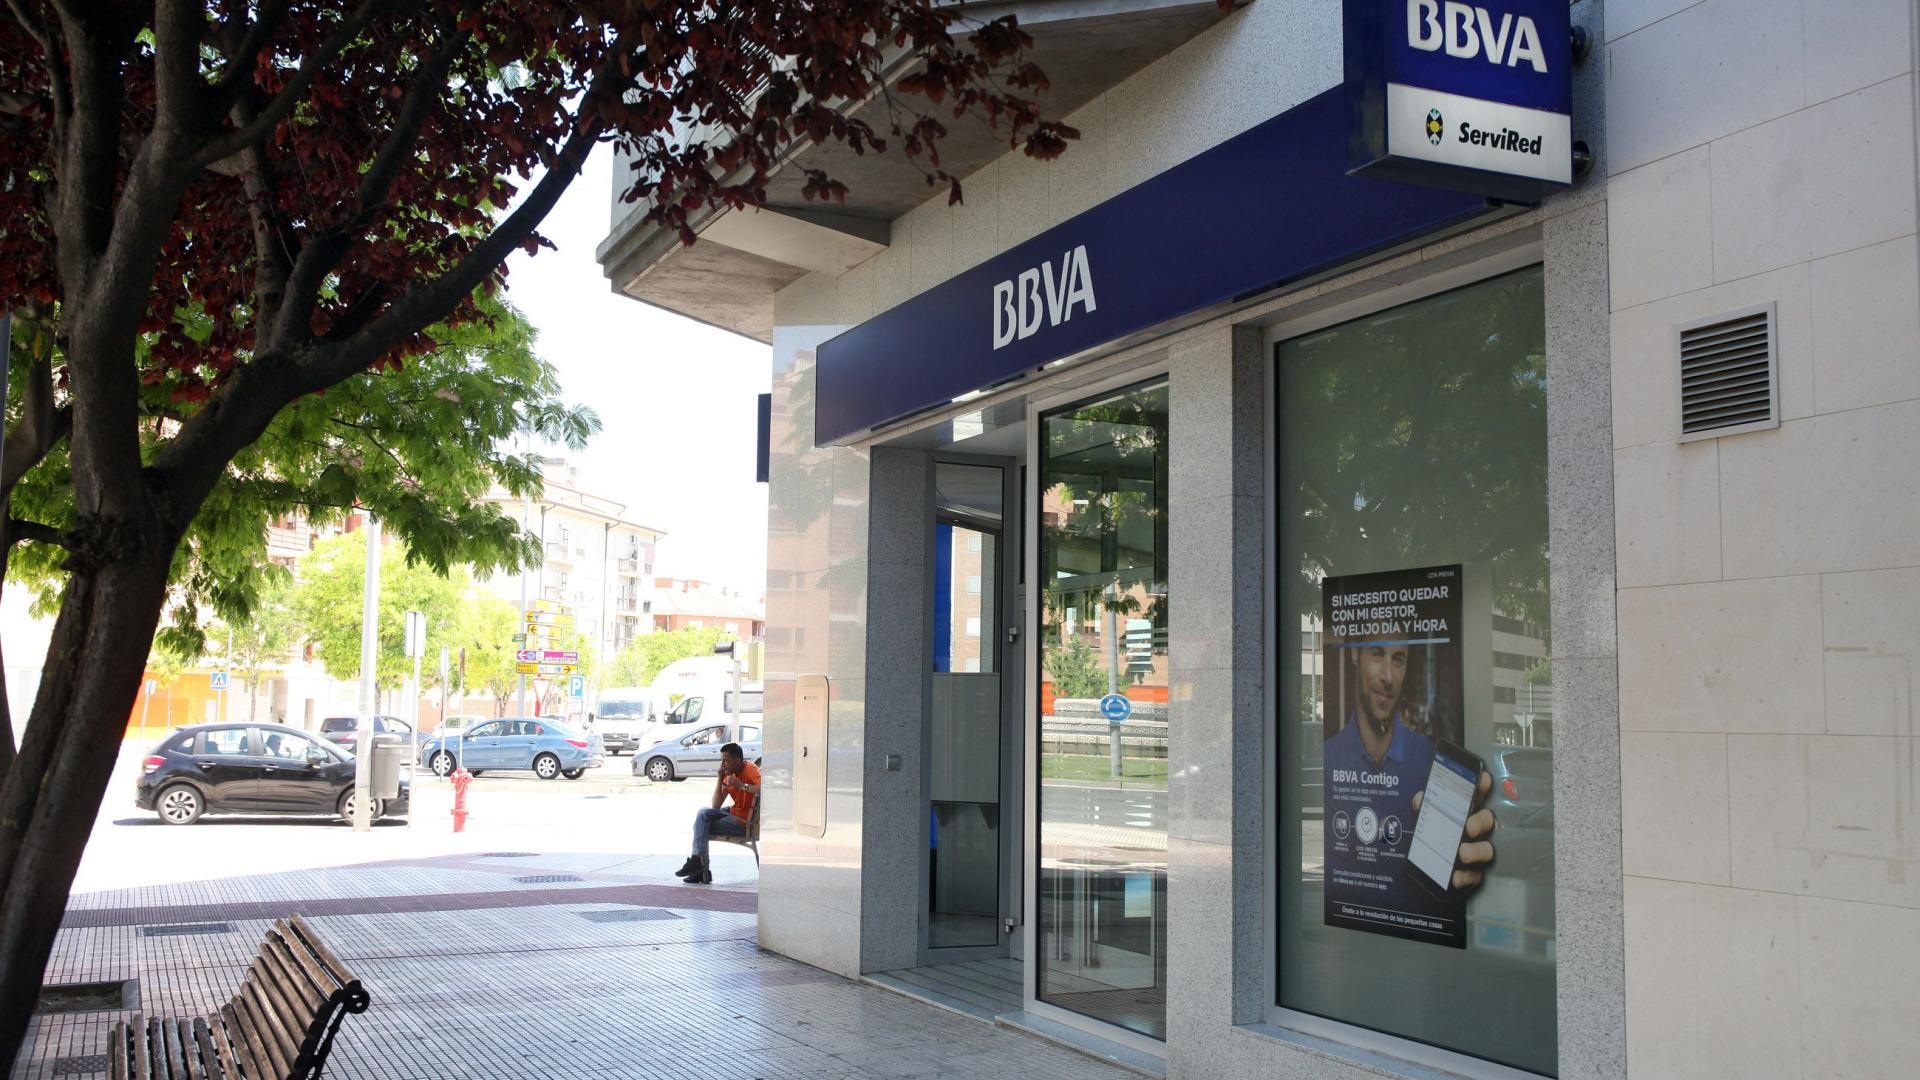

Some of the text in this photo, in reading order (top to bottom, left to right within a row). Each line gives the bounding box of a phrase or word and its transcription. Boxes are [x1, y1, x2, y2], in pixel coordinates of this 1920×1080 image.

[1407, 0, 1548, 73] BBVA
[1458, 122, 1542, 155] ServiRed
[993, 245, 1097, 351] BBVA
[1331, 586, 1449, 607] SI NECESITO QUEDAR
[1332, 604, 1418, 622] CON MI GESTOR,
[1332, 618, 1448, 637] YO ELIJO DÍA Y HORA
[1333, 770, 1399, 788] BBVA Contigo
[1365, 910, 1389, 920] revolución
[1404, 917, 1428, 927] pequeñas
[1428, 921, 1443, 929] cosas
